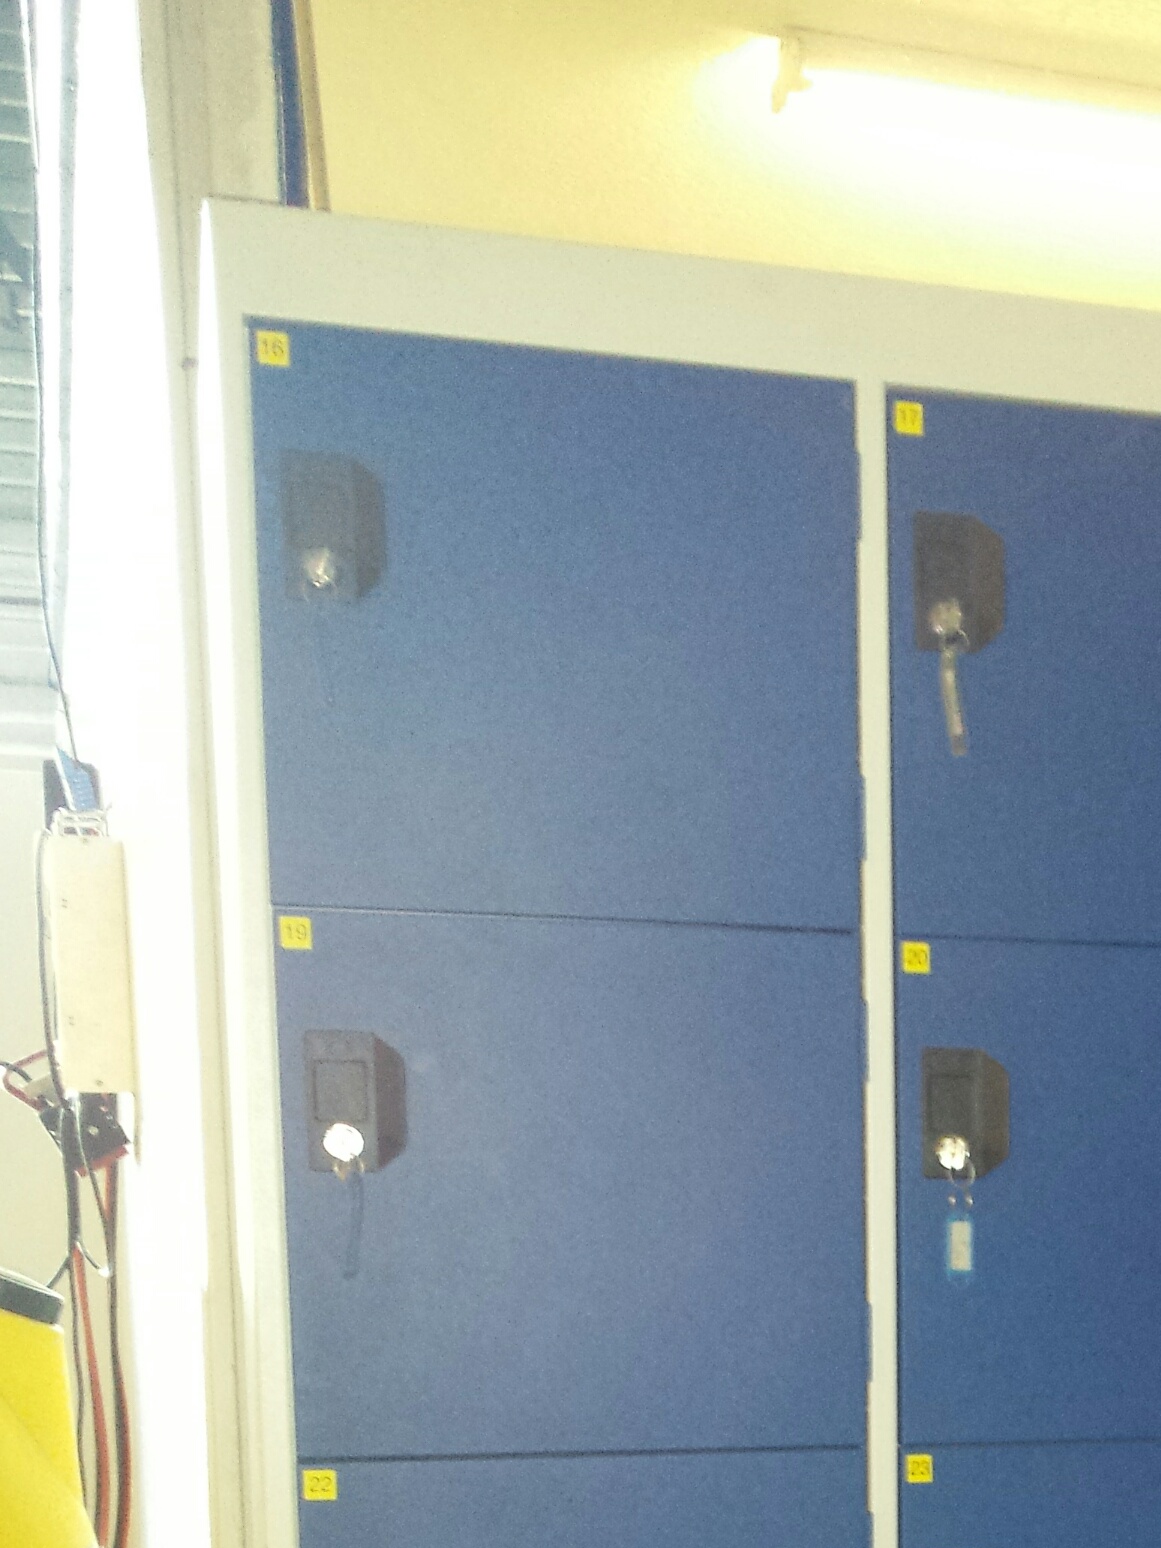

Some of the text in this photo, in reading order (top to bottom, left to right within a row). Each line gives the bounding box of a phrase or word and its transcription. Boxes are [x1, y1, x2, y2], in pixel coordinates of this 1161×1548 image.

[261, 337, 285, 357] 16
[286, 922, 308, 941] 19
[309, 1475, 332, 1493] 22
